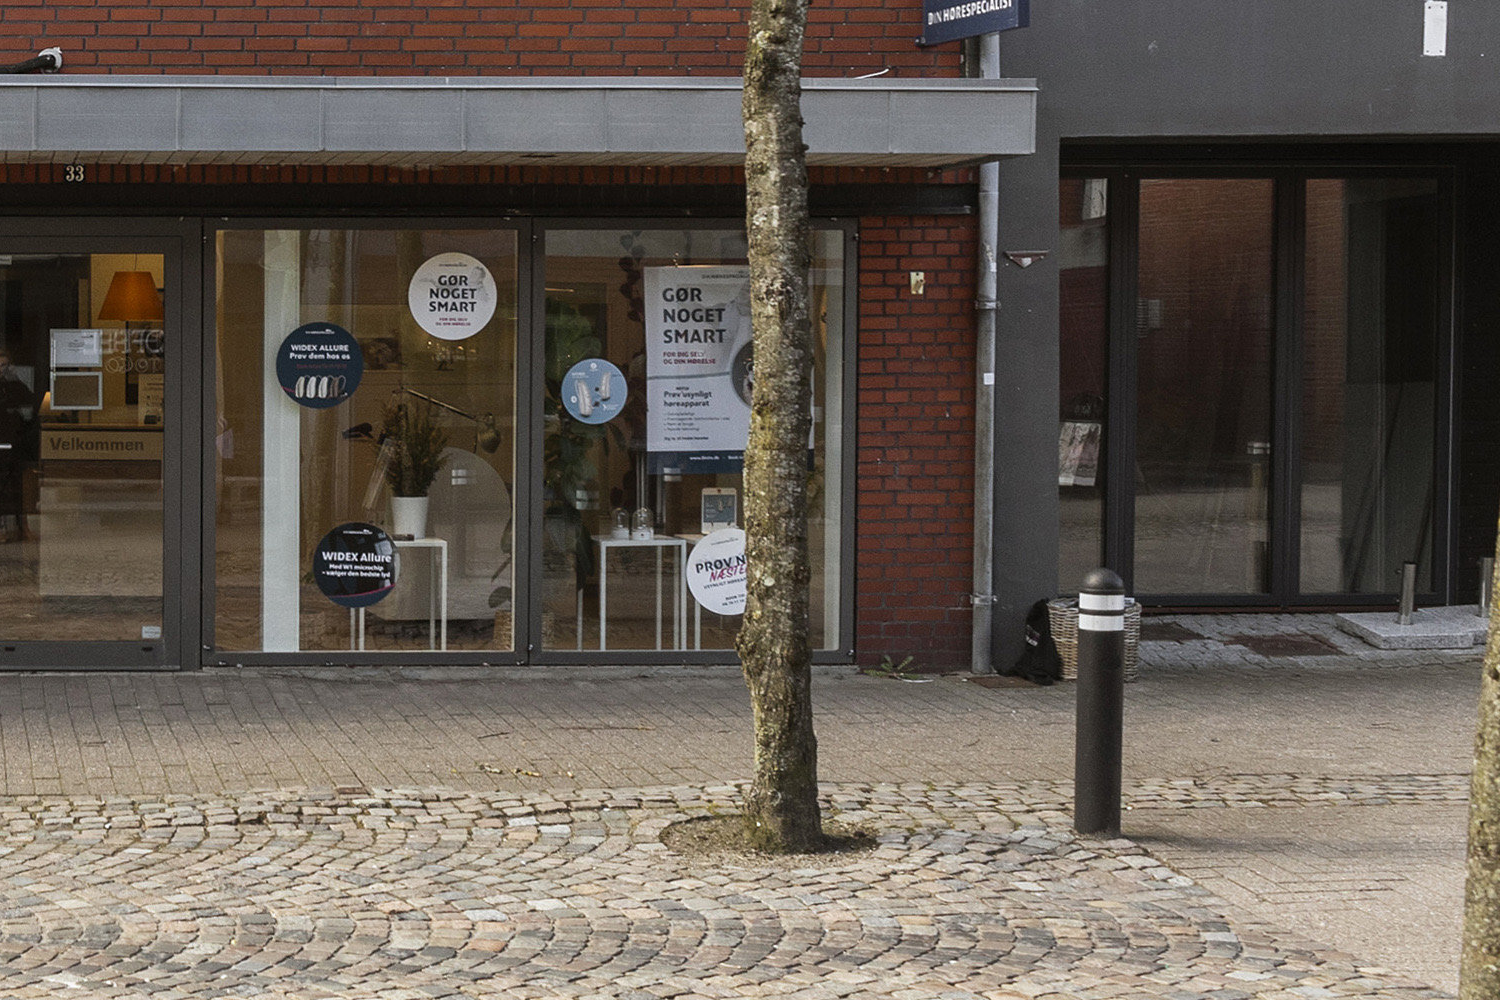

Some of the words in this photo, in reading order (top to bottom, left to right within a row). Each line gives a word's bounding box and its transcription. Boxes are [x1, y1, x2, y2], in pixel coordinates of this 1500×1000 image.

[928, 10, 942, 25] DIN
[66, 165, 84, 181] 33
[438, 275, 468, 286] GØR
[430, 288, 476, 299] NOGET
[662, 288, 702, 302] GØR
[429, 301, 476, 312] SMART
[663, 308, 725, 322] NOGET
[663, 329, 726, 343] SMART
[682, 391, 712, 399] usynligt
[664, 400, 709, 408] høreapparat
[50, 437, 144, 451] Velkommen
[322, 551, 358, 561] WIDEX
[360, 552, 392, 562] Allure
[696, 558, 732, 574] PRØV
[710, 564, 746, 582] NÆSTE
